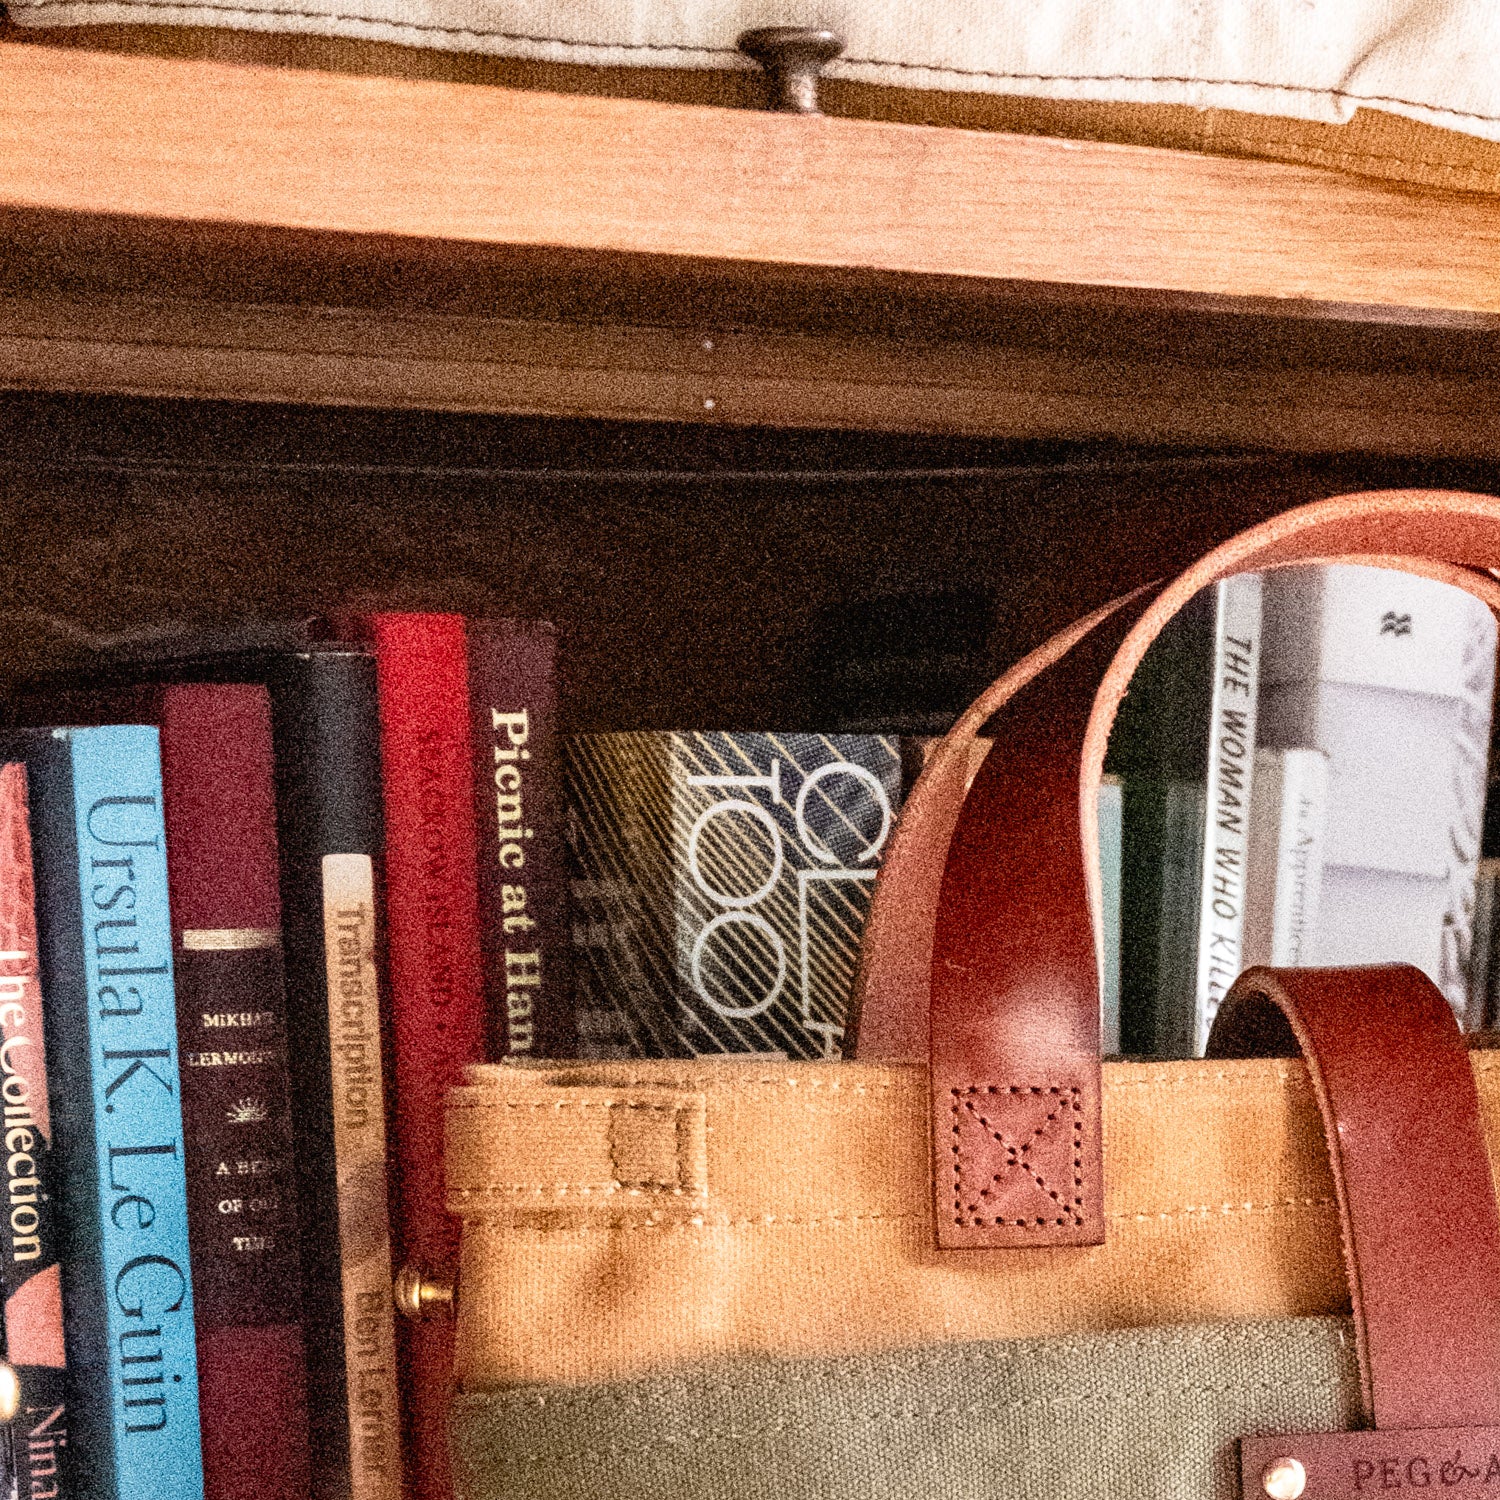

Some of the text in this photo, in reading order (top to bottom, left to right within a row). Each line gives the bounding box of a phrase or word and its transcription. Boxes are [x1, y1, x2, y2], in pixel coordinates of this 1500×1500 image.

[492, 708, 534, 869] Picnic
[1206, 634, 1252, 1030] THE WOMAN WHO KILLE
[502, 884, 536, 934] at
[0, 951, 49, 1262] The Collection
[86, 795, 188, 1435] Ursula K. Le Guin
[218, 1199, 242, 1214] OF
[338, 902, 386, 1477] Transcription Ben Lerner
[27, 1405, 67, 1490] Nina
